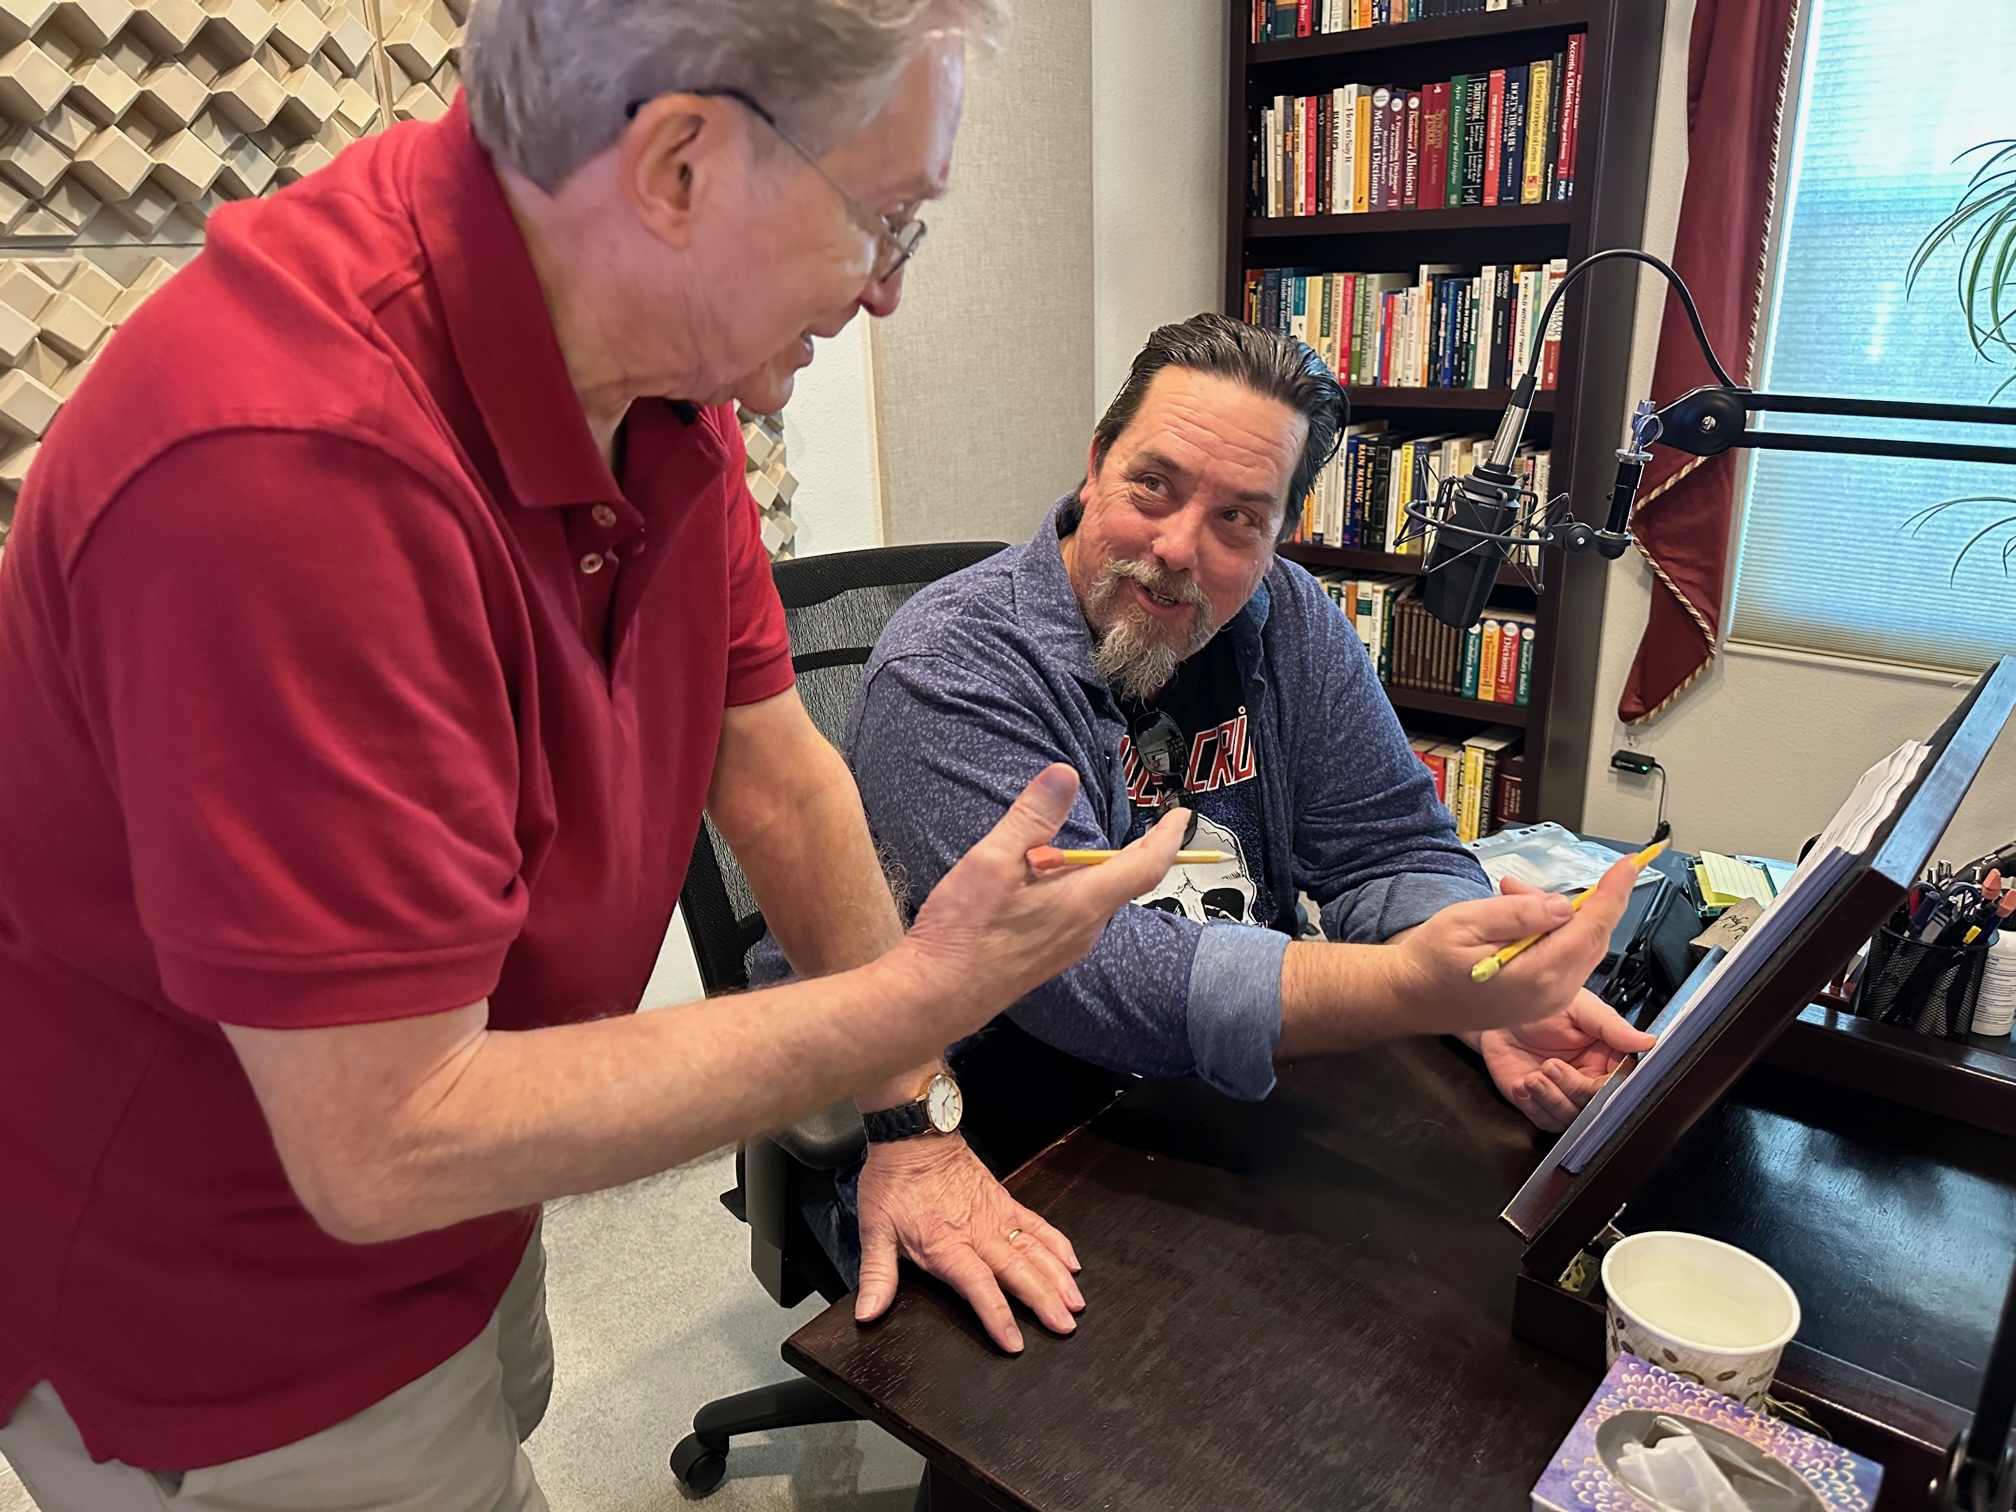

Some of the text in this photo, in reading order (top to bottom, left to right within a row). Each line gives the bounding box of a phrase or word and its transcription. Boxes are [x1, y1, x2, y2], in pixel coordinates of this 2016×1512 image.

[1567, 40, 1578, 70] Accents
[1454, 85, 1462, 100] Ayto
[1472, 83, 1482, 120] CULTURAL
[1535, 76, 1544, 99] Lifetime
[1564, 79, 1574, 108] Dialects
[1318, 112, 1325, 125] VO
[1346, 108, 1354, 129] How
[1407, 111, 1415, 142] Dictionary
[1424, 114, 1436, 145] FINDER
[1434, 109, 1447, 148] SYNONYM
[1452, 106, 1461, 138] Dictionary
[1507, 82, 1519, 152] ROGET'S THESAURUS
[1531, 100, 1543, 136] Encyclopedia
[1342, 140, 1352, 155] Say
[1346, 130, 1353, 139] to
[1393, 122, 1401, 161] Pronouncing
[1370, 109, 1383, 205] Medical Dictionary
[1530, 144, 1540, 162] Letters
[1392, 162, 1401, 194] Dictionary
[1406, 151, 1417, 196] Allusions
[1280, 301, 1286, 309] to
[1355, 444, 1366, 503] RAIN MAKING
[1366, 479, 1372, 488] Do
[1364, 489, 1372, 500] You
[1363, 501, 1371, 521] Know?
[1465, 635, 1476, 687] Vocabulary Builder
[1482, 634, 1493, 680] Thesaurus
[1497, 637, 1512, 684] Dictionary
[1519, 641, 1529, 695] Vocabulary Builder
[1482, 780, 1491, 808] ENGLISH
